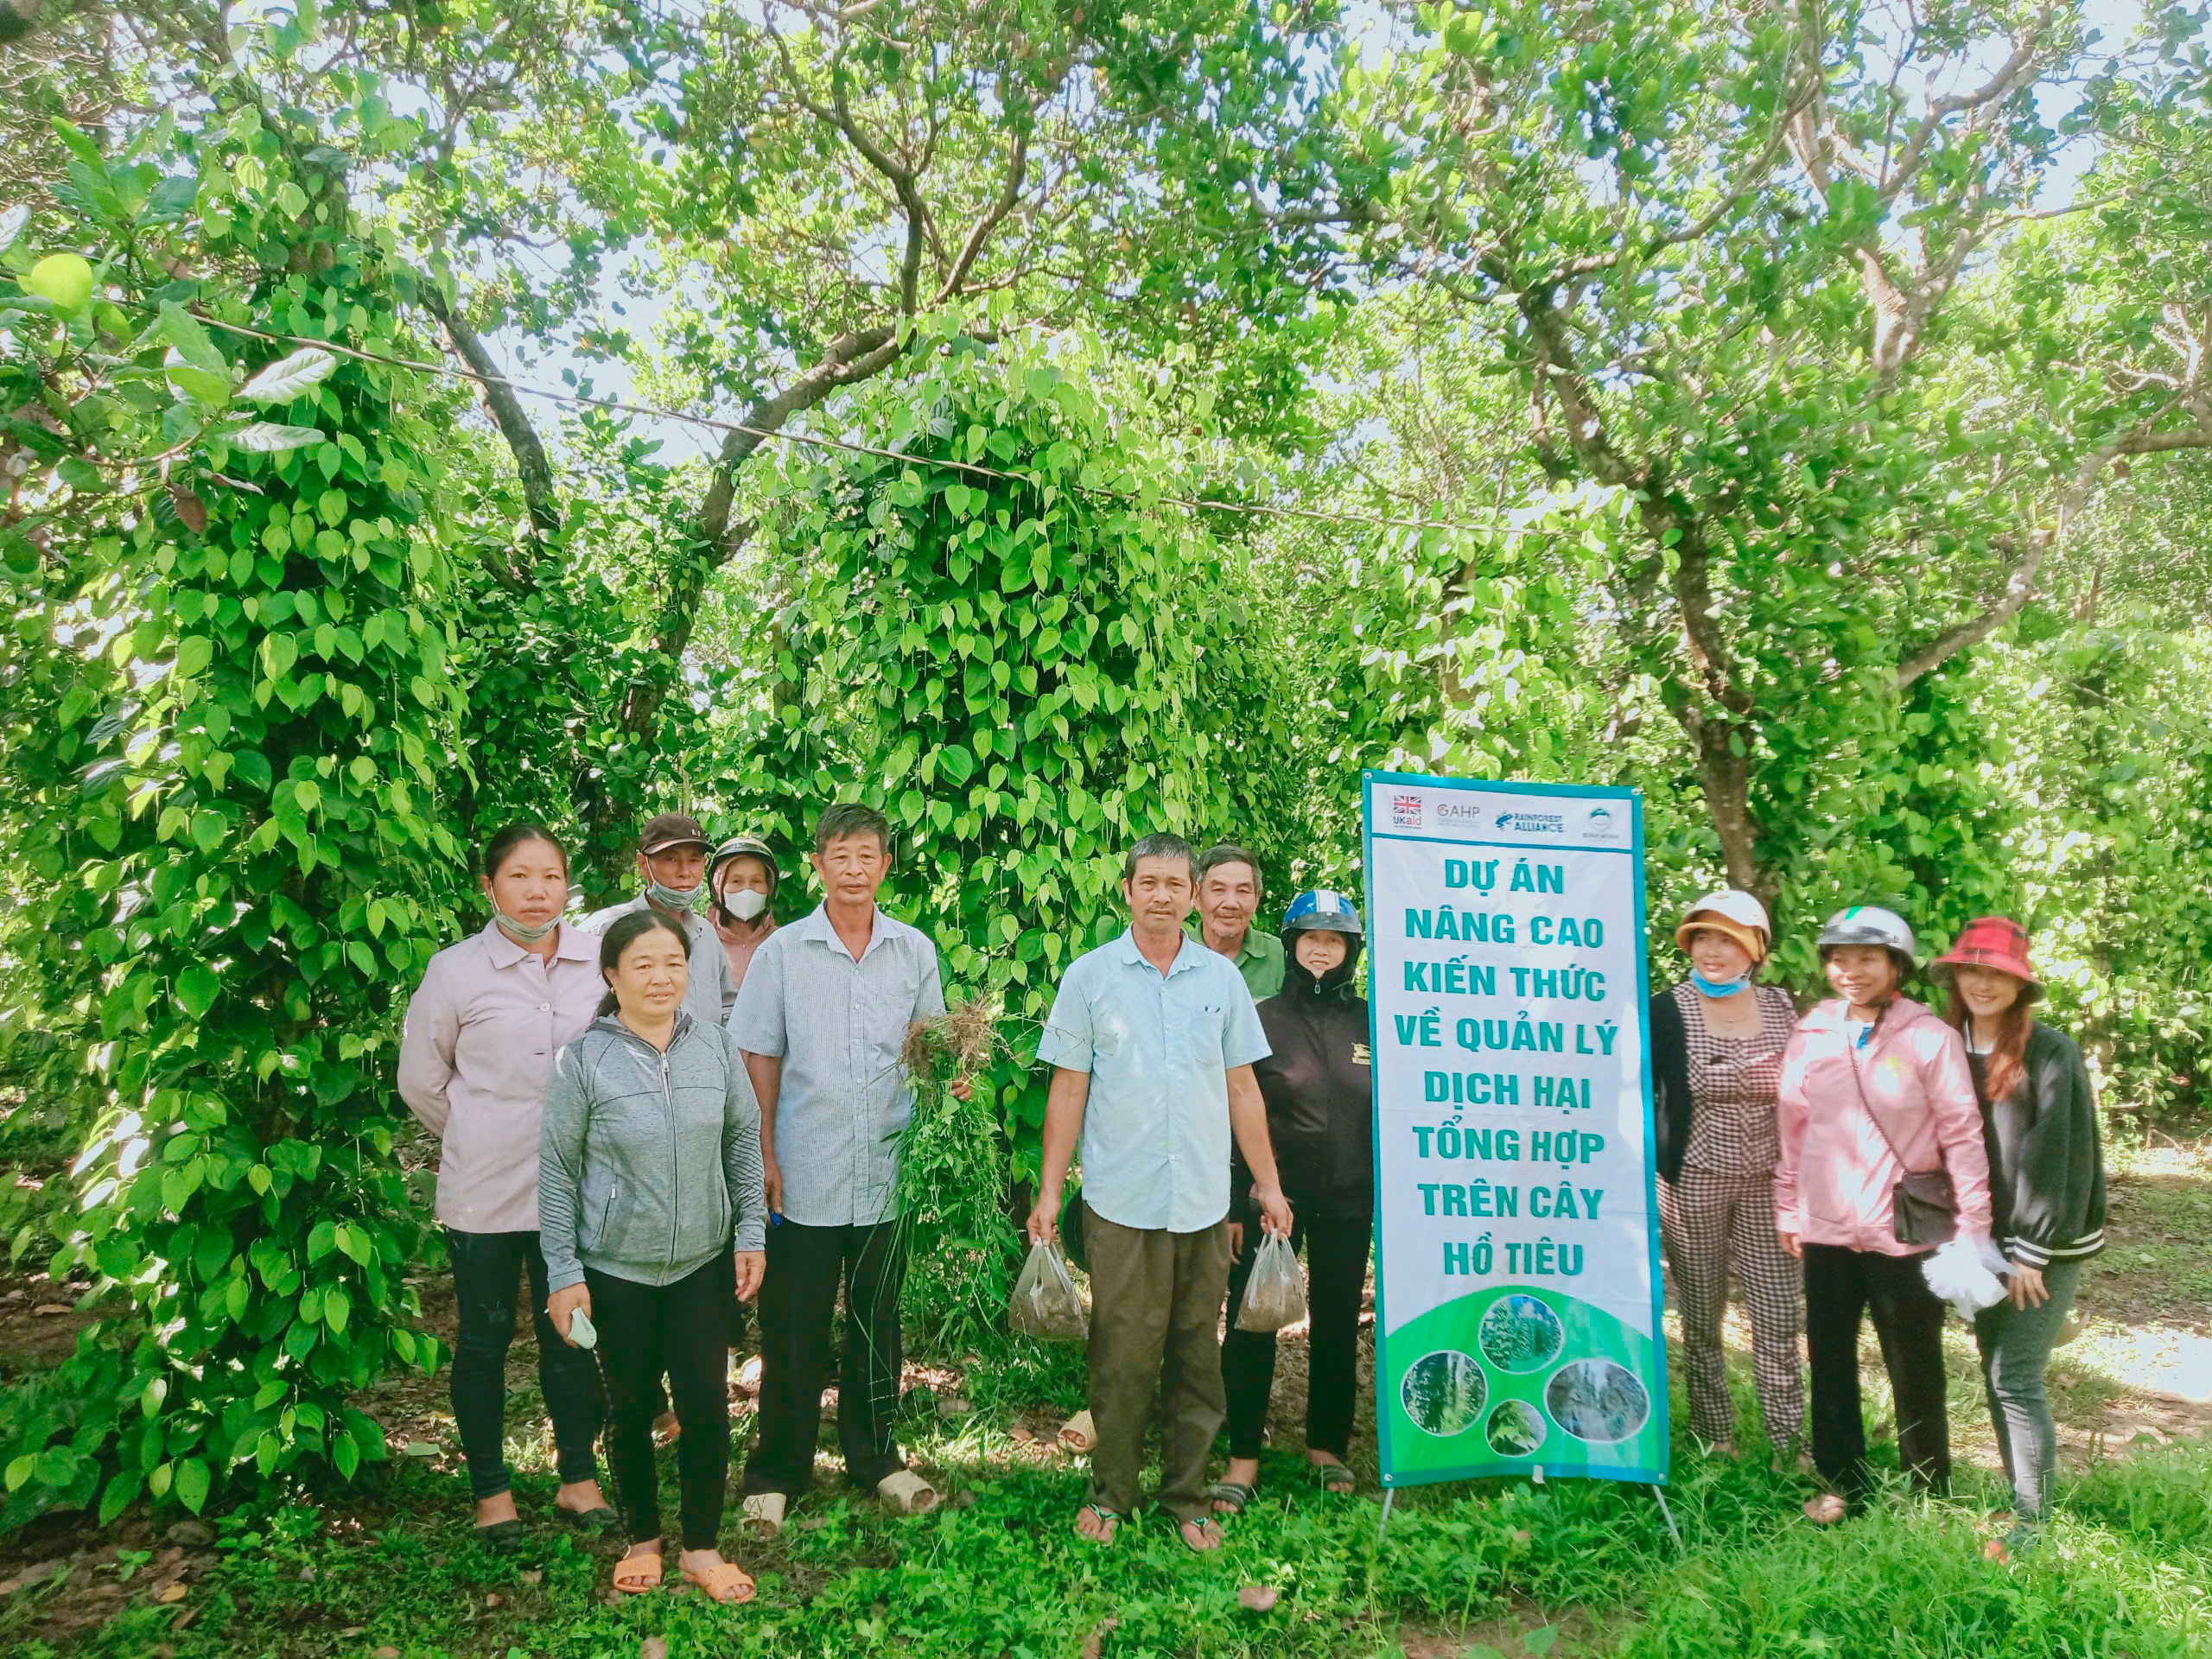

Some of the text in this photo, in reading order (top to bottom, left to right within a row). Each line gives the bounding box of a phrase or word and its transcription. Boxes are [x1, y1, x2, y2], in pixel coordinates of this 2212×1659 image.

[1437, 804, 1480, 818] GAHP
[1514, 813, 1562, 823] RAINFOREST
[1514, 822, 1564, 833] ALLIANCE
[1445, 858, 1564, 897] DỰ ÁN
[1406, 905, 1604, 948] NÂNG CAO
[1403, 954, 1607, 1001] KIẾN THỨC
[1394, 1006, 1618, 1056] VỀ QUẢN LÝ
[1424, 1071, 1590, 1114] DỊCH HẠI
[1412, 1115, 1604, 1170] TỔNG HỢP
[1417, 1178, 1604, 1220] TRÊN CÂY
[1444, 1231, 1583, 1277] HỒ TIÊU
